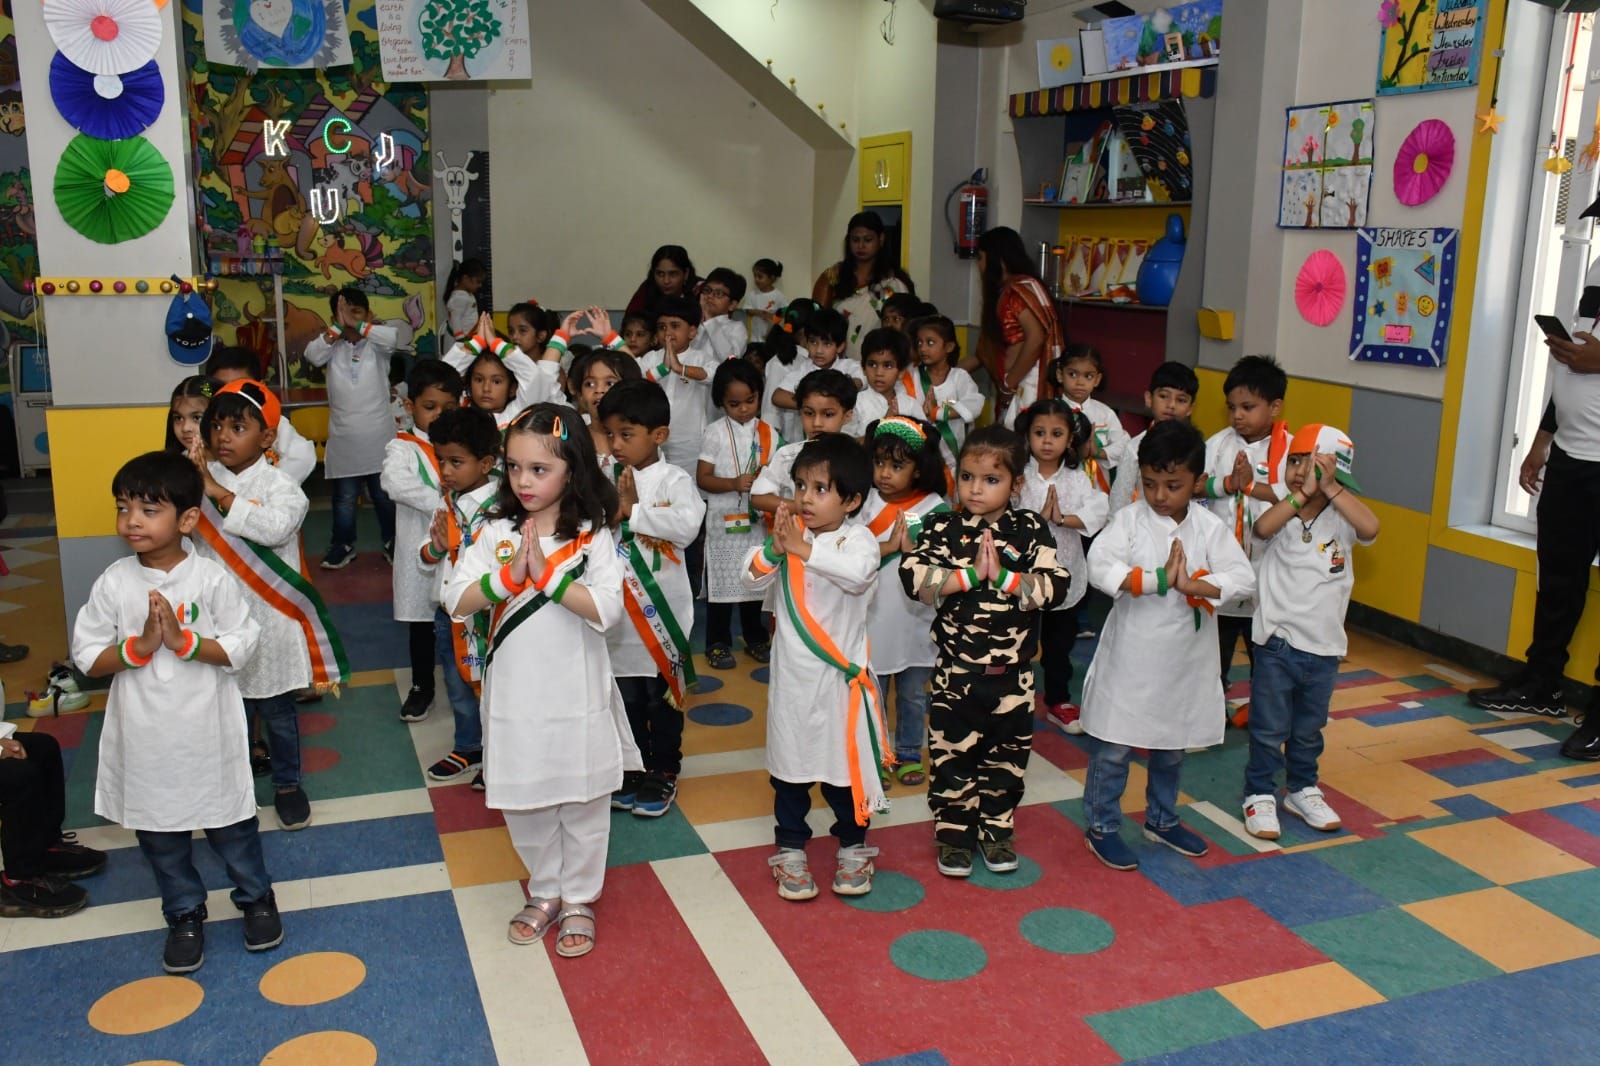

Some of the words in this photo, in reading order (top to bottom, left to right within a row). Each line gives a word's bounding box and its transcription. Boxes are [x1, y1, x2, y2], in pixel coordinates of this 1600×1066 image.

[263, 119, 292, 156] K
[323, 117, 352, 154] C
[309, 188, 340, 225] U
[1376, 229, 1428, 248] SHAPES
